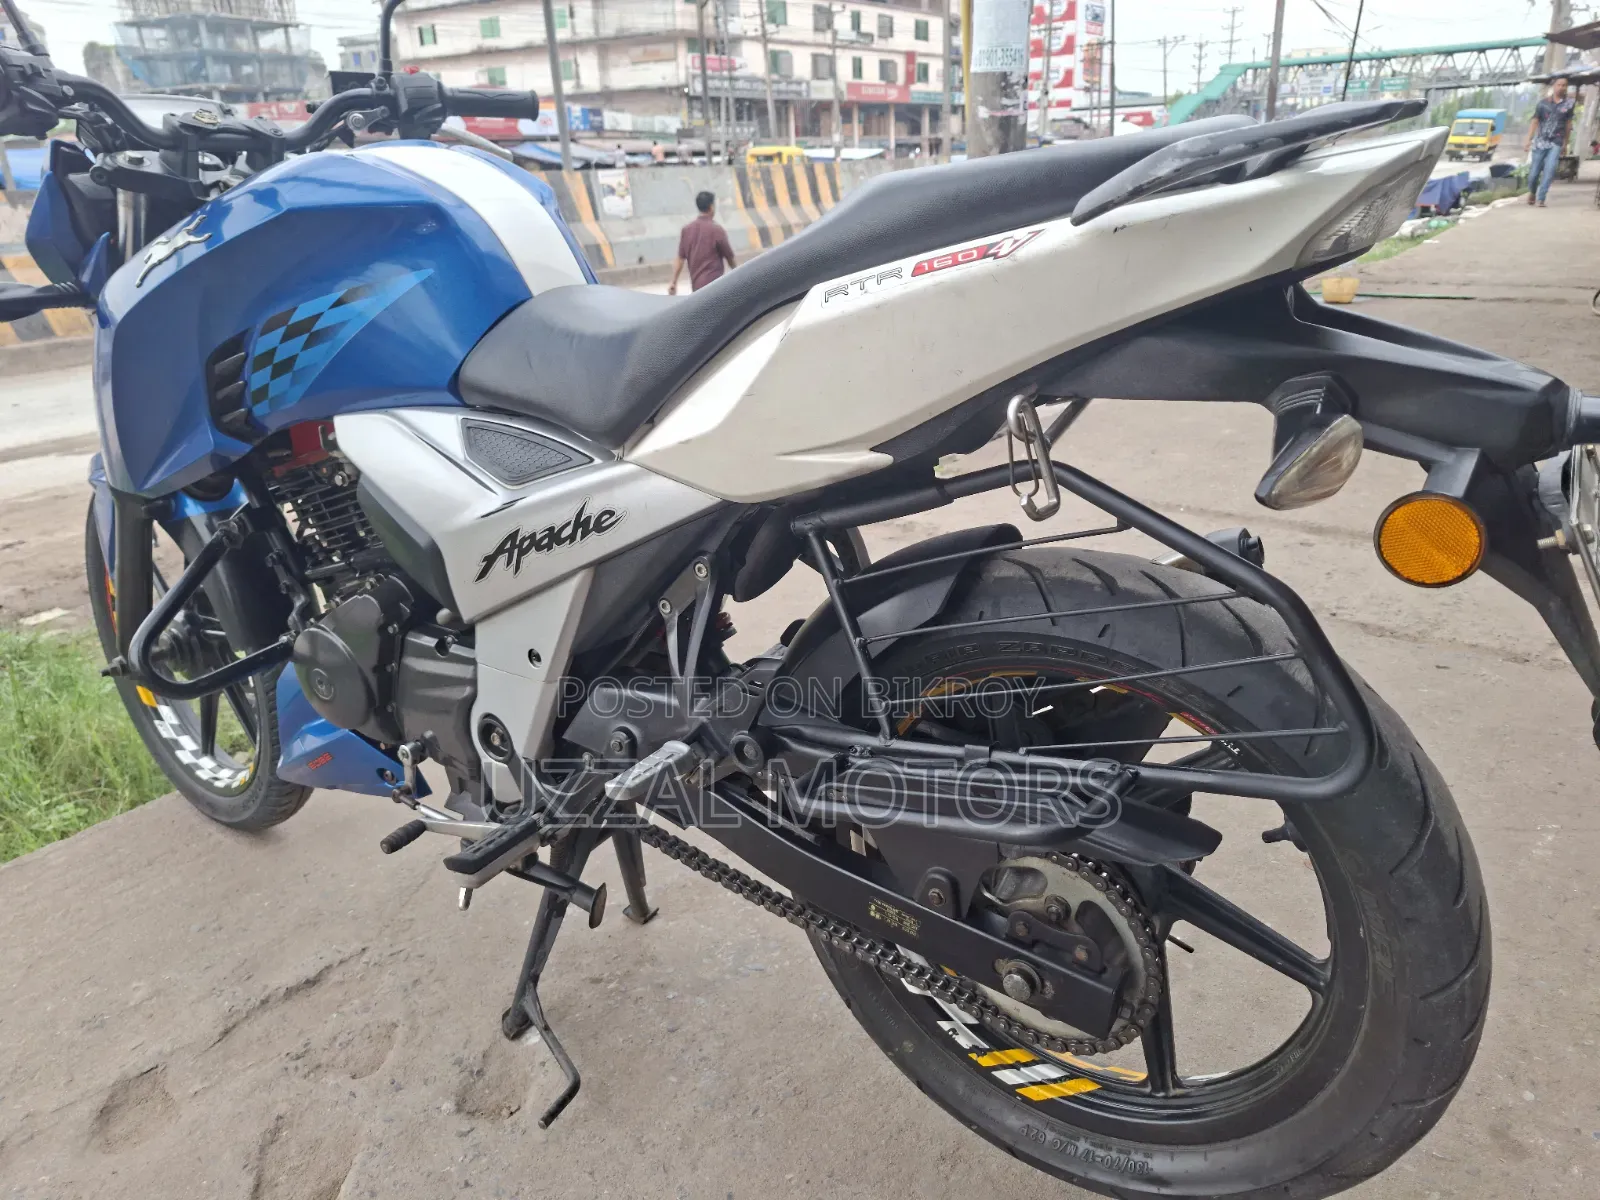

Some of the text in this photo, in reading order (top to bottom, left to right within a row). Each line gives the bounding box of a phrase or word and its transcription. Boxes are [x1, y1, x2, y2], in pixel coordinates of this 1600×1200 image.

[824, 267, 903, 303] RTR
[919, 249, 978, 272] 160
[474, 496, 627, 582] Apache
[1052, 1139, 1077, 1157] M/C
[1080, 1151, 1149, 1175] 130/70-17
